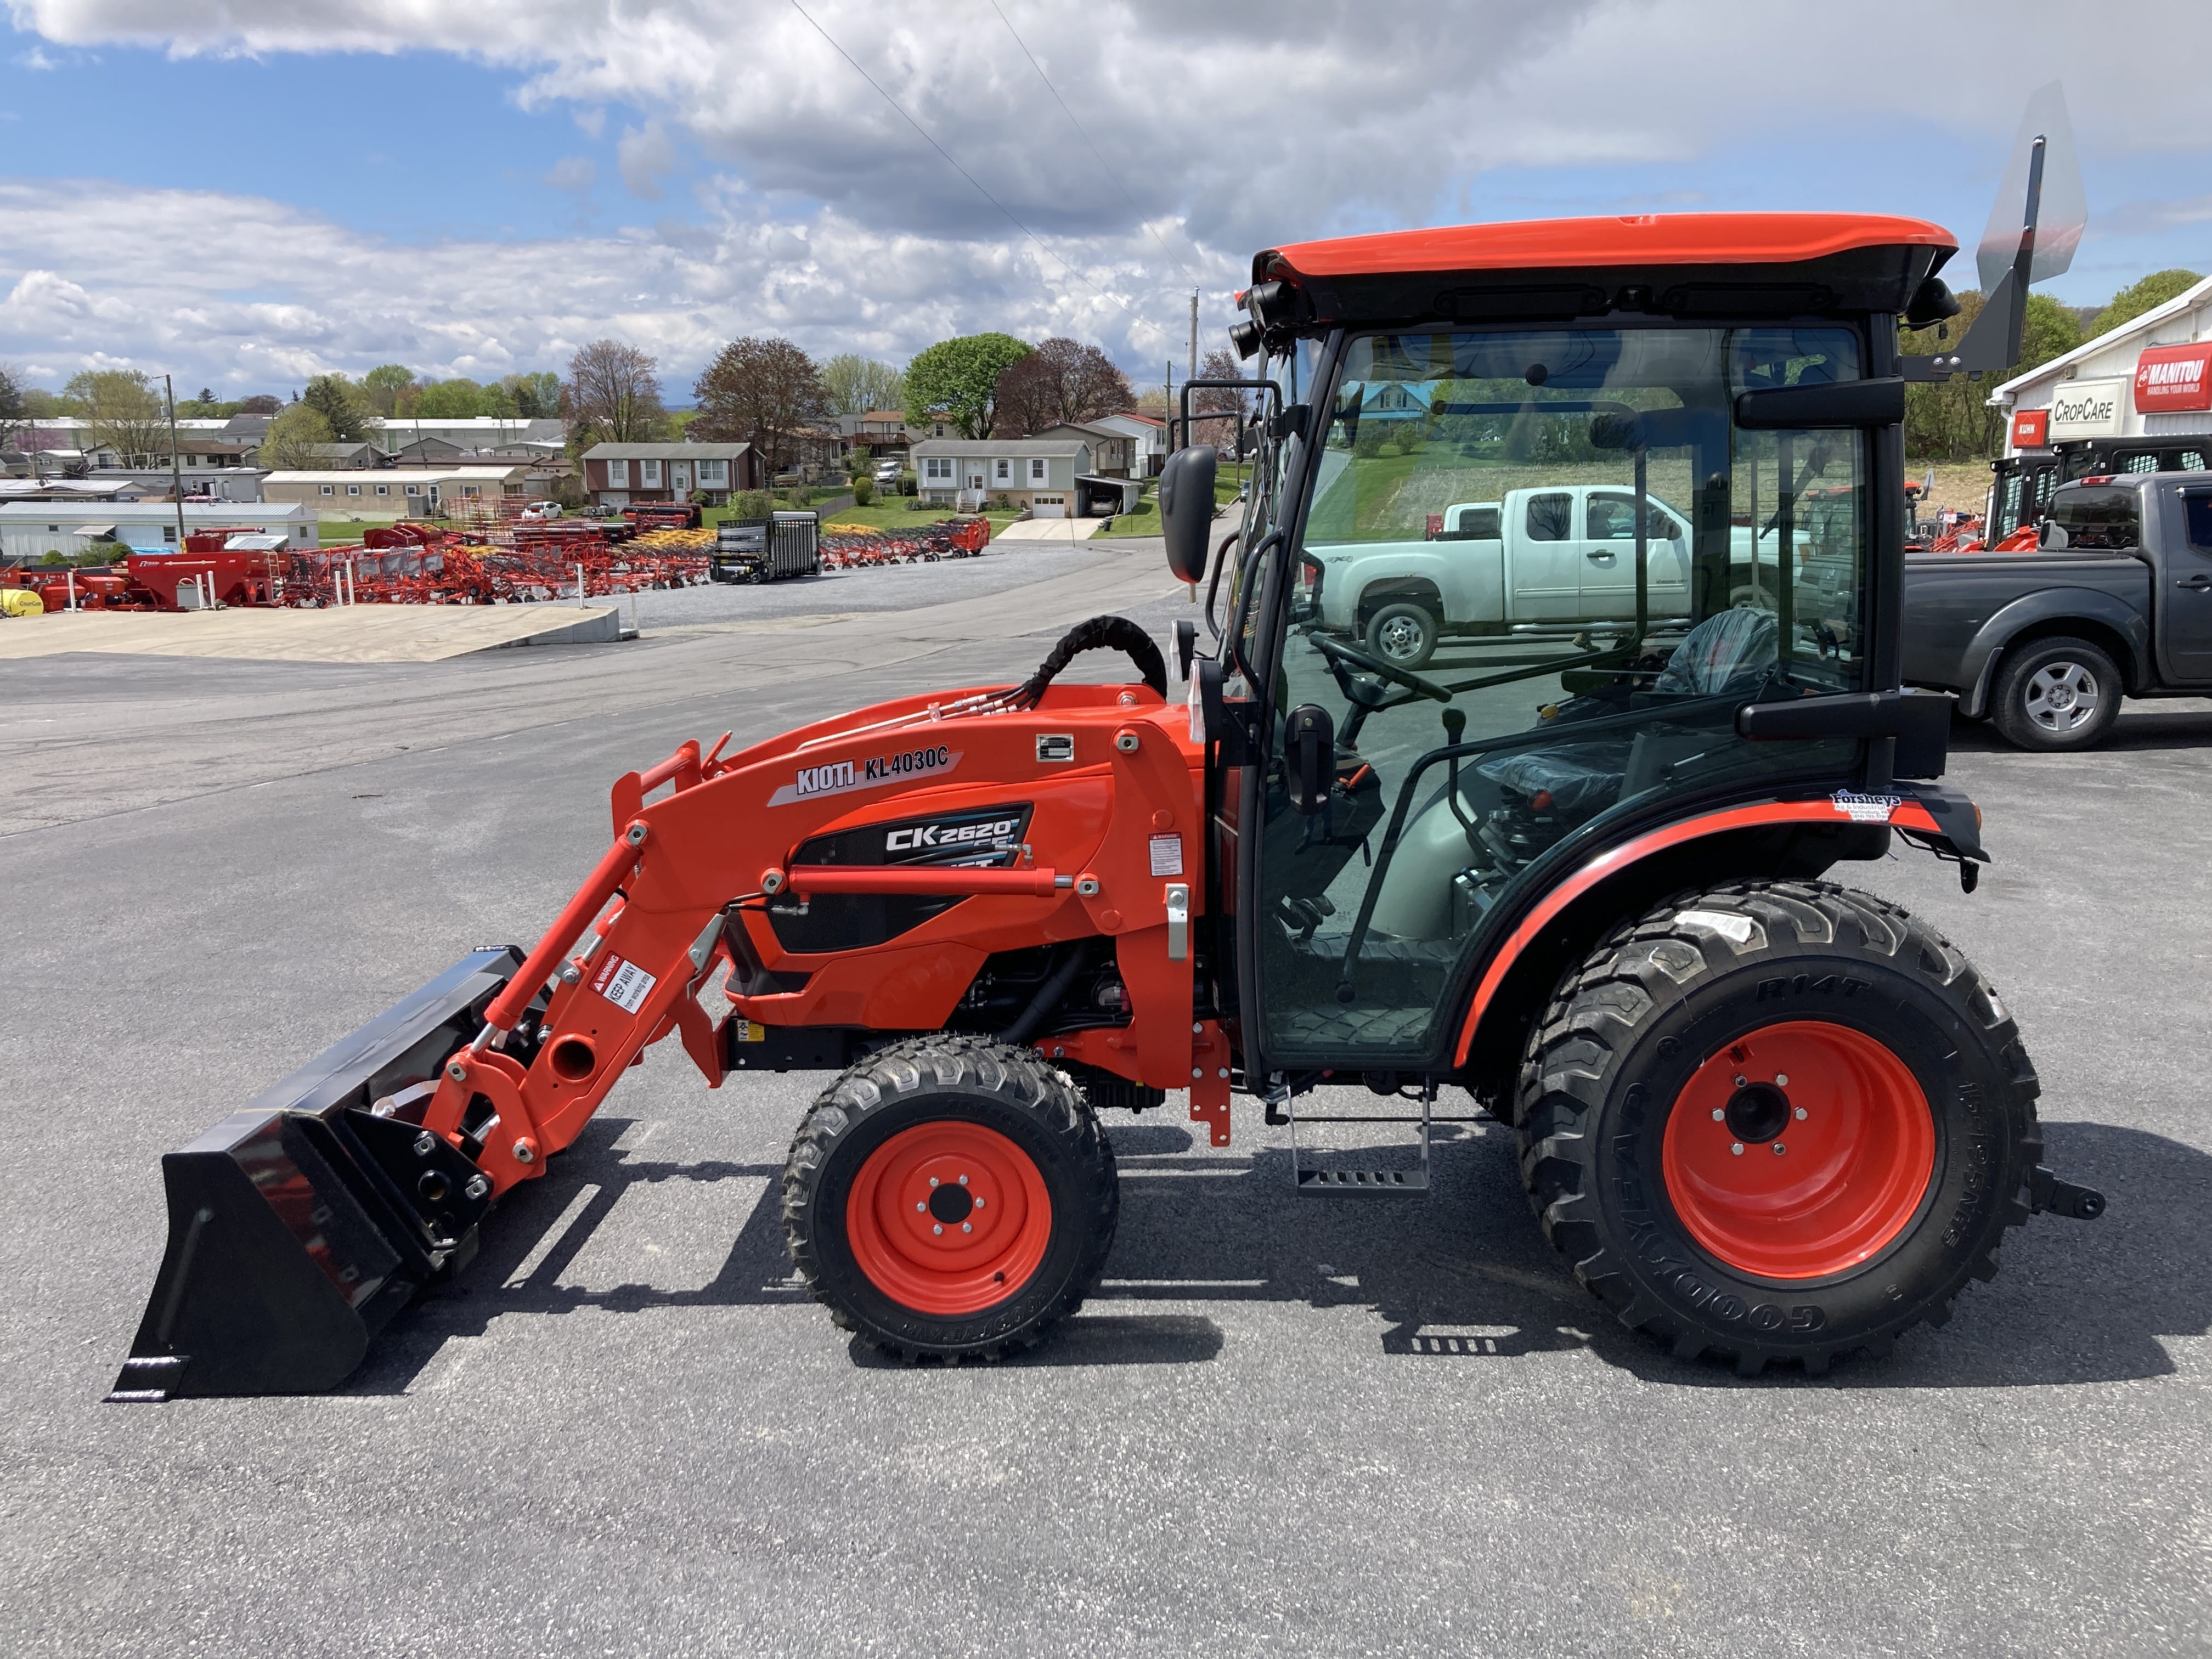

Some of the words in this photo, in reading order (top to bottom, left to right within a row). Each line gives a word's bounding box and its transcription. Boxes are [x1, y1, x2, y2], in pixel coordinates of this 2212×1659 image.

[2148, 359, 2205, 385] MANITOU
[2147, 385, 2169, 395] HANDLING
[2170, 384, 2182, 393] YOUR
[2183, 382, 2200, 393] WORLD
[2019, 424, 2035, 435] KUHN
[797, 760, 855, 795] KIOTI
[865, 745, 949, 782] KL4030C
[1831, 794, 1900, 807] Forsheys
[598, 955, 619, 982] WARNING
[608, 983, 625, 1003] KEEP
[619, 964, 637, 986] AWAY
[624, 998, 635, 1009] from
[631, 983, 646, 1000] working
[641, 974, 651, 985] area
[1611, 1082, 1827, 1334] GOODYEAR
